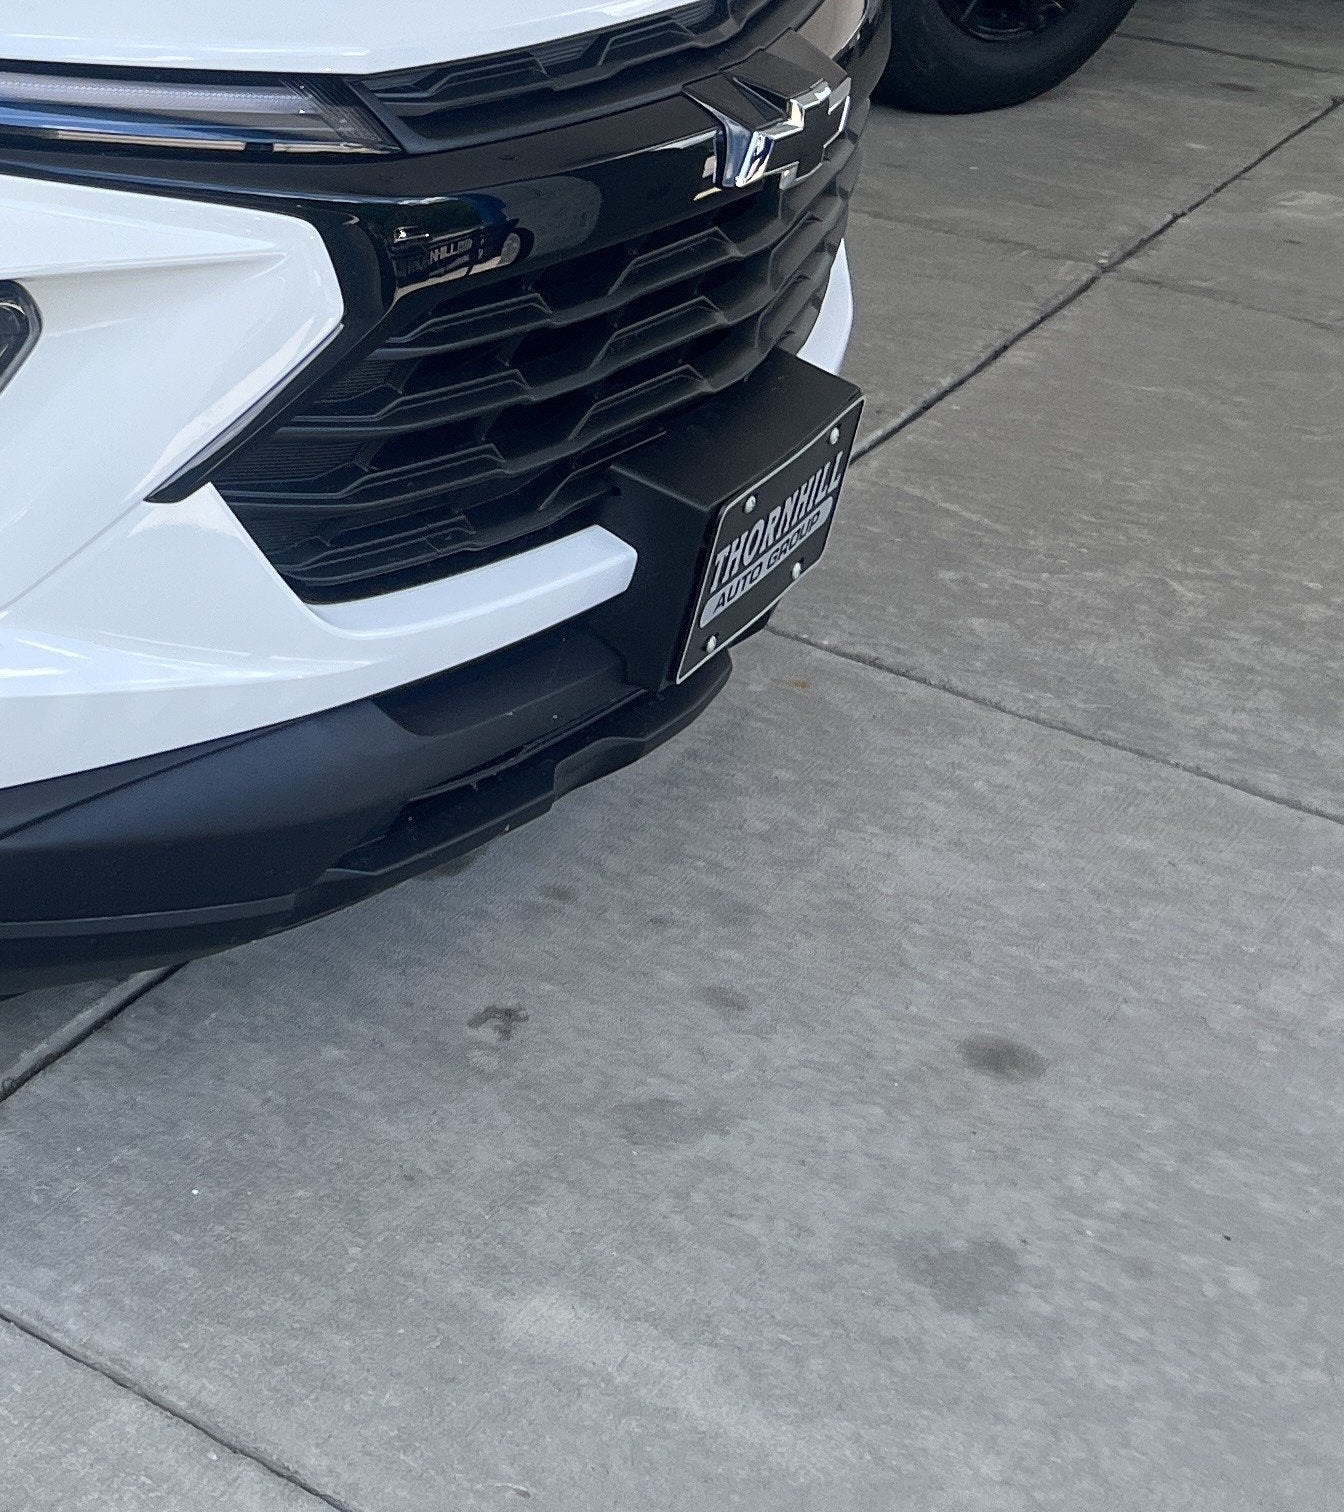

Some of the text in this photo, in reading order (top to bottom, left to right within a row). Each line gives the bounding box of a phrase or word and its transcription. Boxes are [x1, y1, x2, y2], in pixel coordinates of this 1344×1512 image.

[710, 451, 844, 594] THORNHILL
[713, 510, 821, 613] AUTO GROUP
